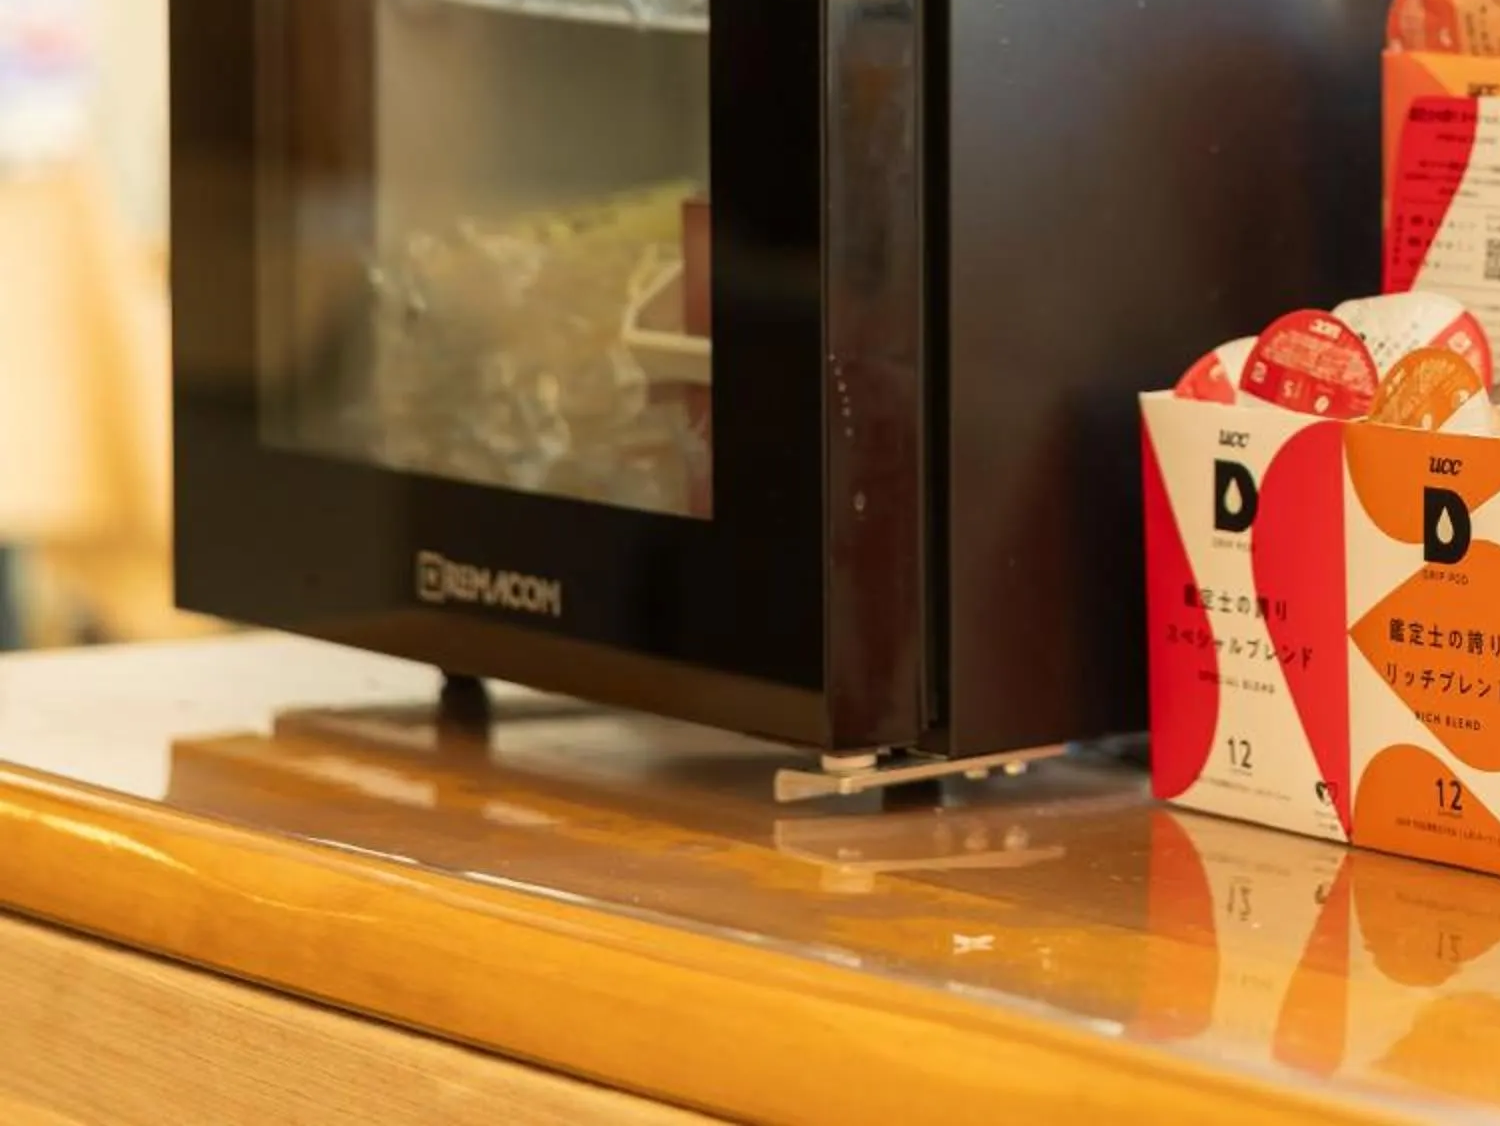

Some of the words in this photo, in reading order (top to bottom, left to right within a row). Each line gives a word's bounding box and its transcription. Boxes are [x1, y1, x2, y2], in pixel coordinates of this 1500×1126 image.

[1219, 430, 1250, 448] UCC
[1429, 456, 1464, 476] UCC
[1214, 458, 1259, 533] D
[1423, 486, 1472, 565] D
[1445, 715, 1481, 731] BLEND
[1227, 737, 1253, 769] 12
[1435, 778, 1463, 811] 12
